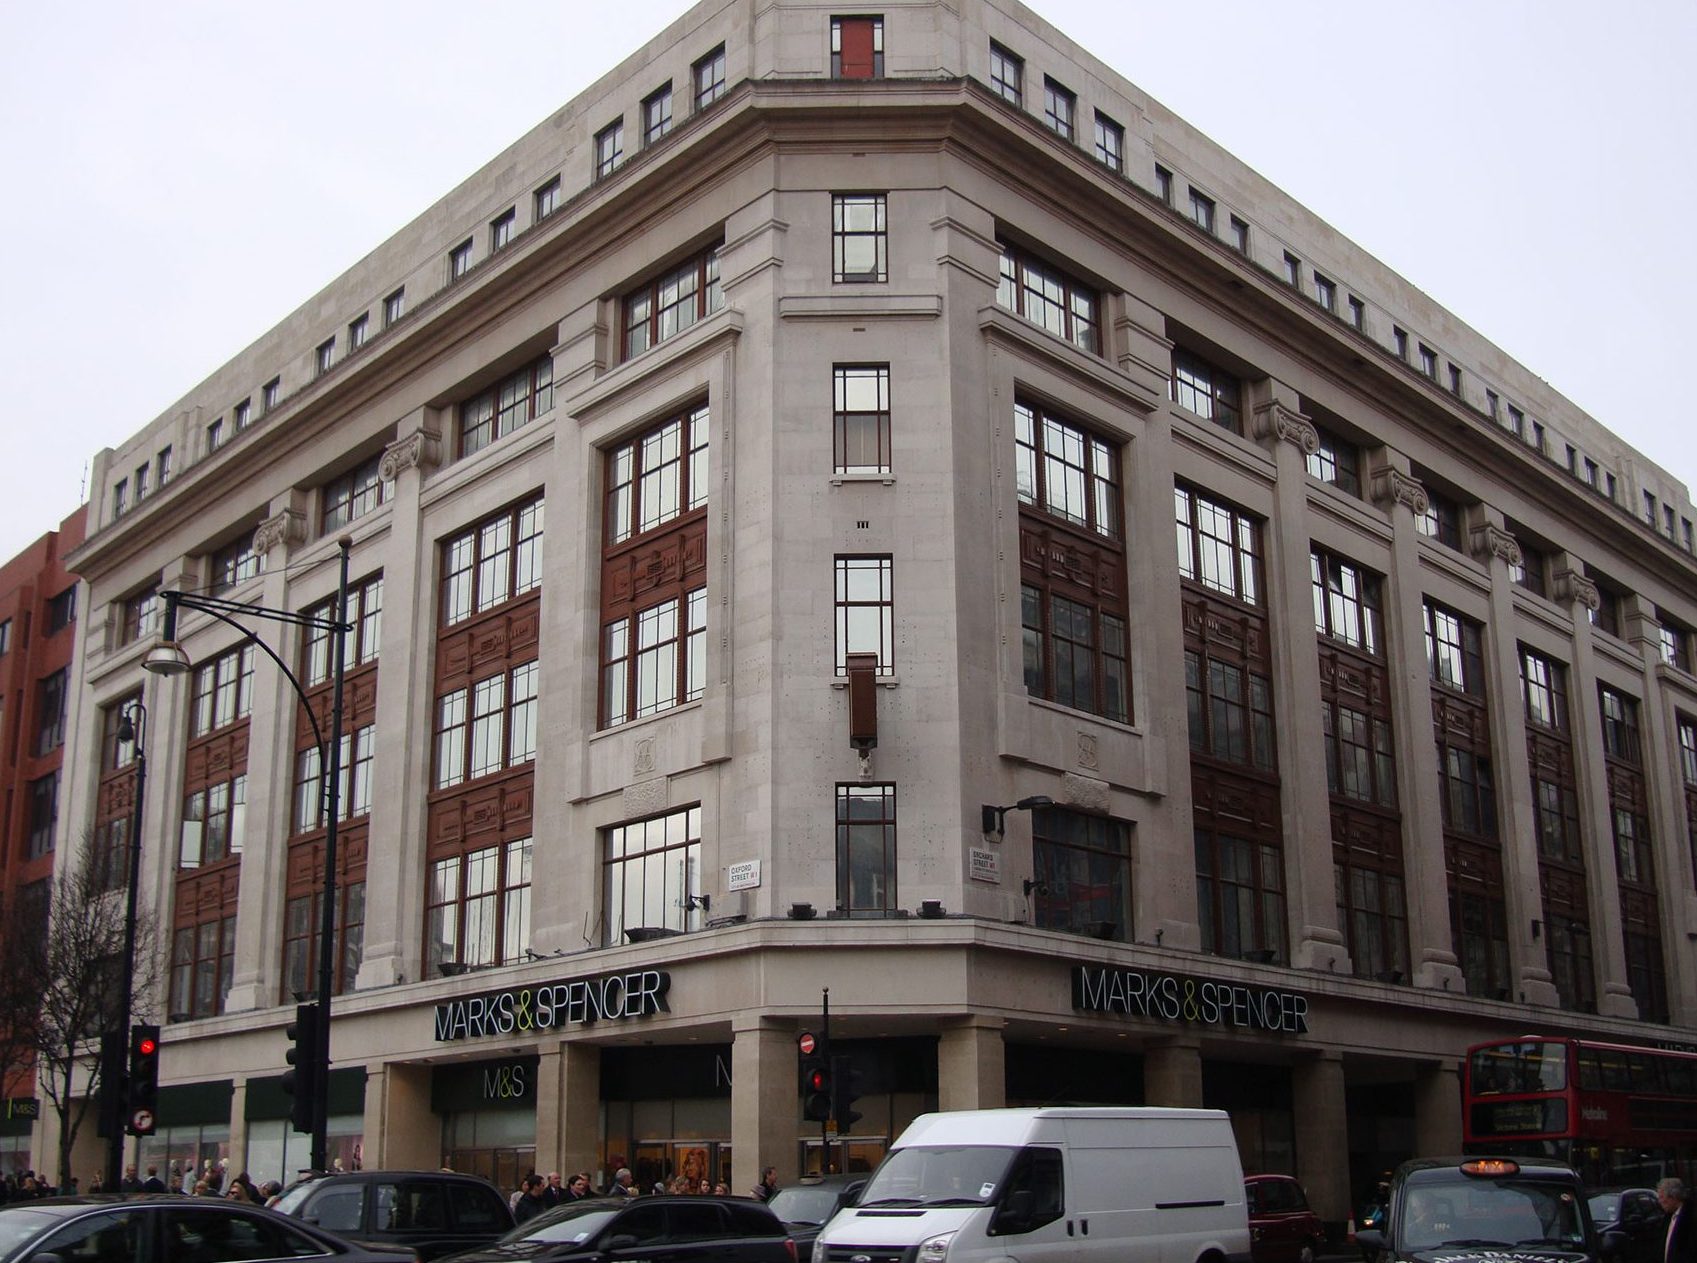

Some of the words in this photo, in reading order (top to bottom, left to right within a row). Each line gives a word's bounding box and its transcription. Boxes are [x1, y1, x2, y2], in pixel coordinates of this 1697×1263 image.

[731, 864, 752, 874] OXFORD
[731, 872, 749, 882] STREET
[484, 1065, 524, 1098] M&S
